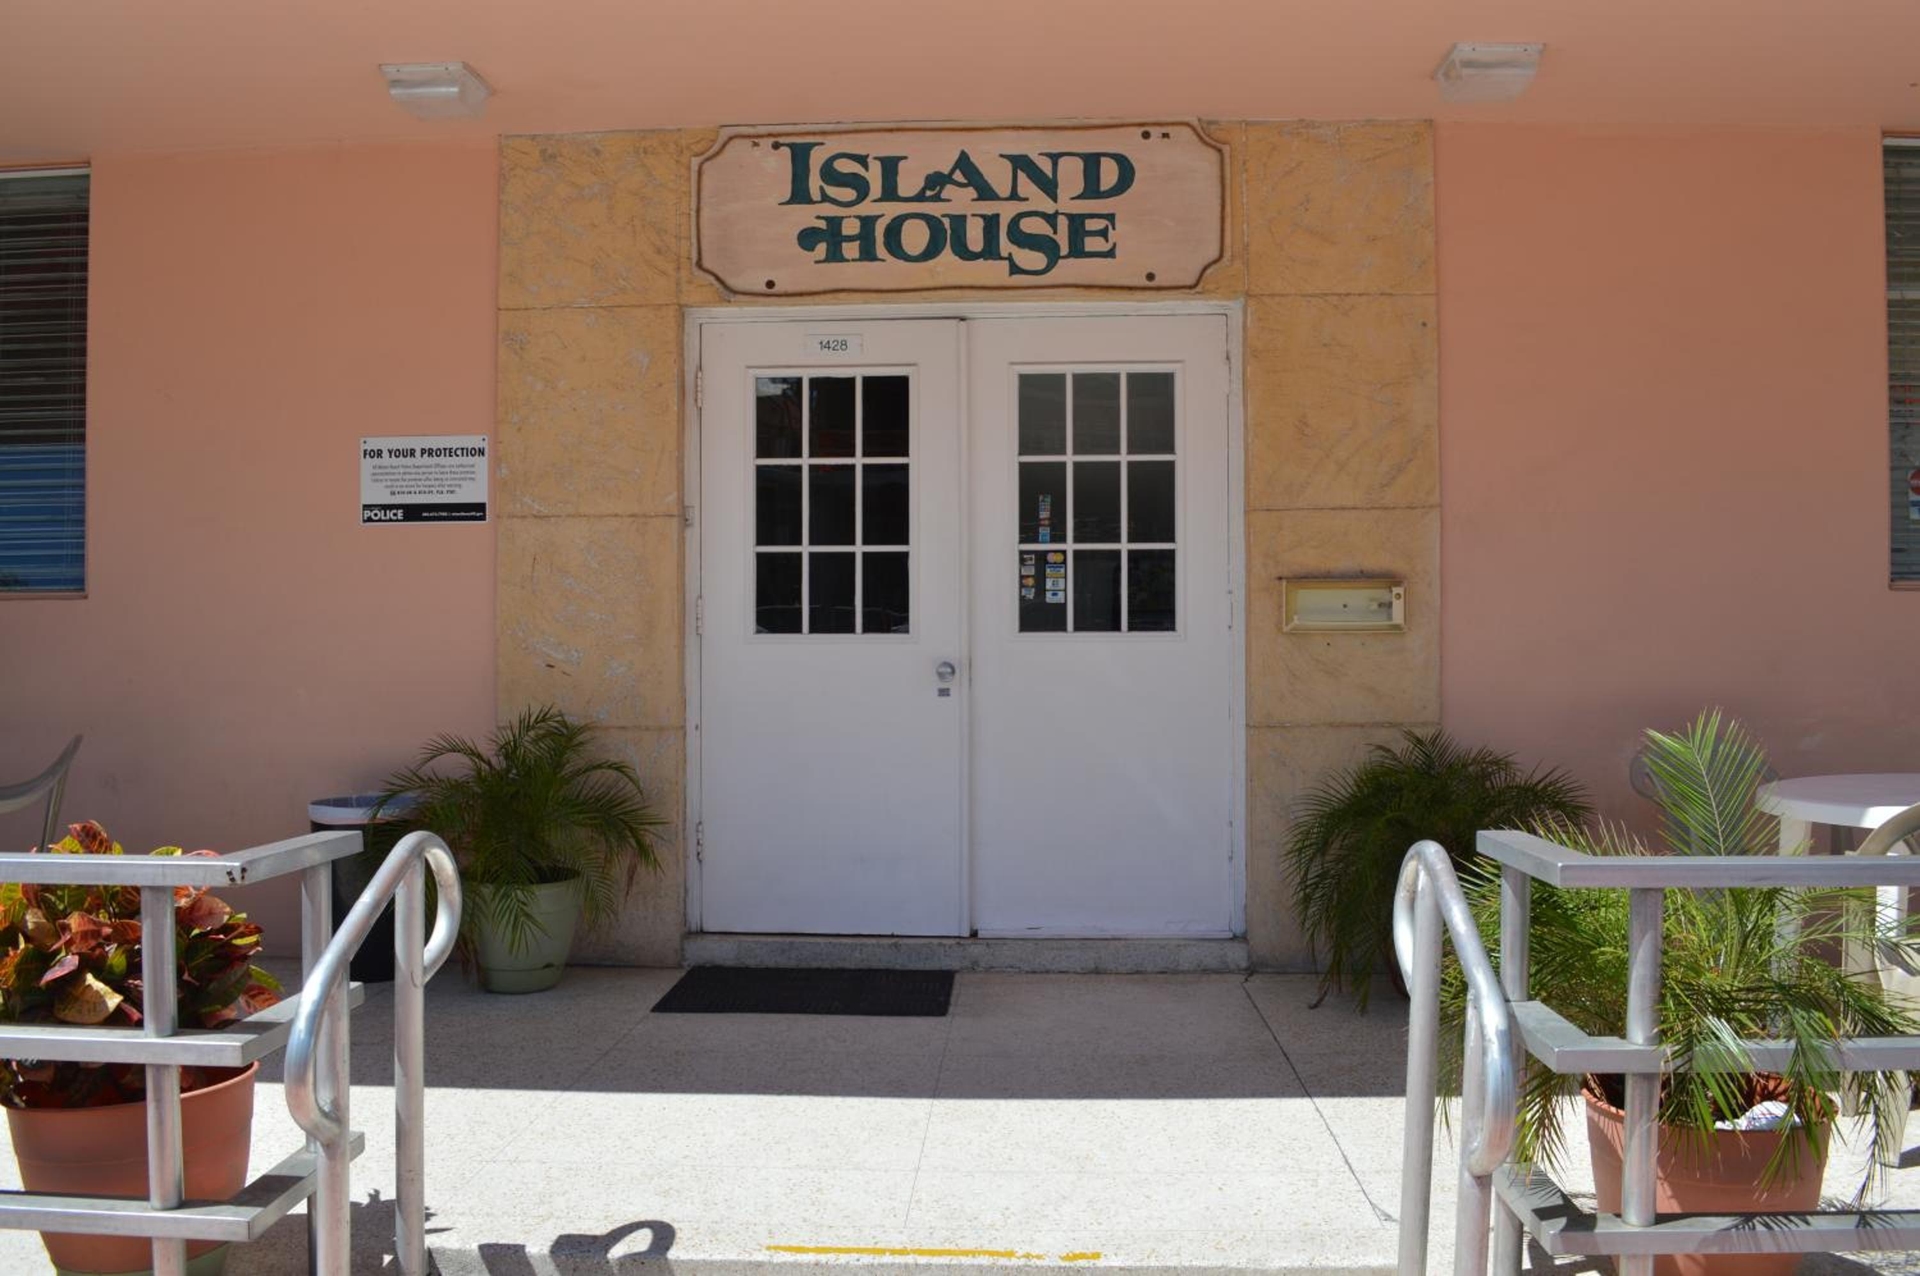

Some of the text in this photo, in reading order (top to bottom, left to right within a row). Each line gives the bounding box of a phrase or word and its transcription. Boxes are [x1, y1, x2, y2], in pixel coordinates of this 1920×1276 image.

[777, 141, 1136, 207] ISLAND
[796, 209, 1117, 277] HOUSE
[819, 339, 848, 352] 1428
[363, 447, 485, 459] FOR YOUR PROTECTION
[363, 509, 404, 521] POLICE
